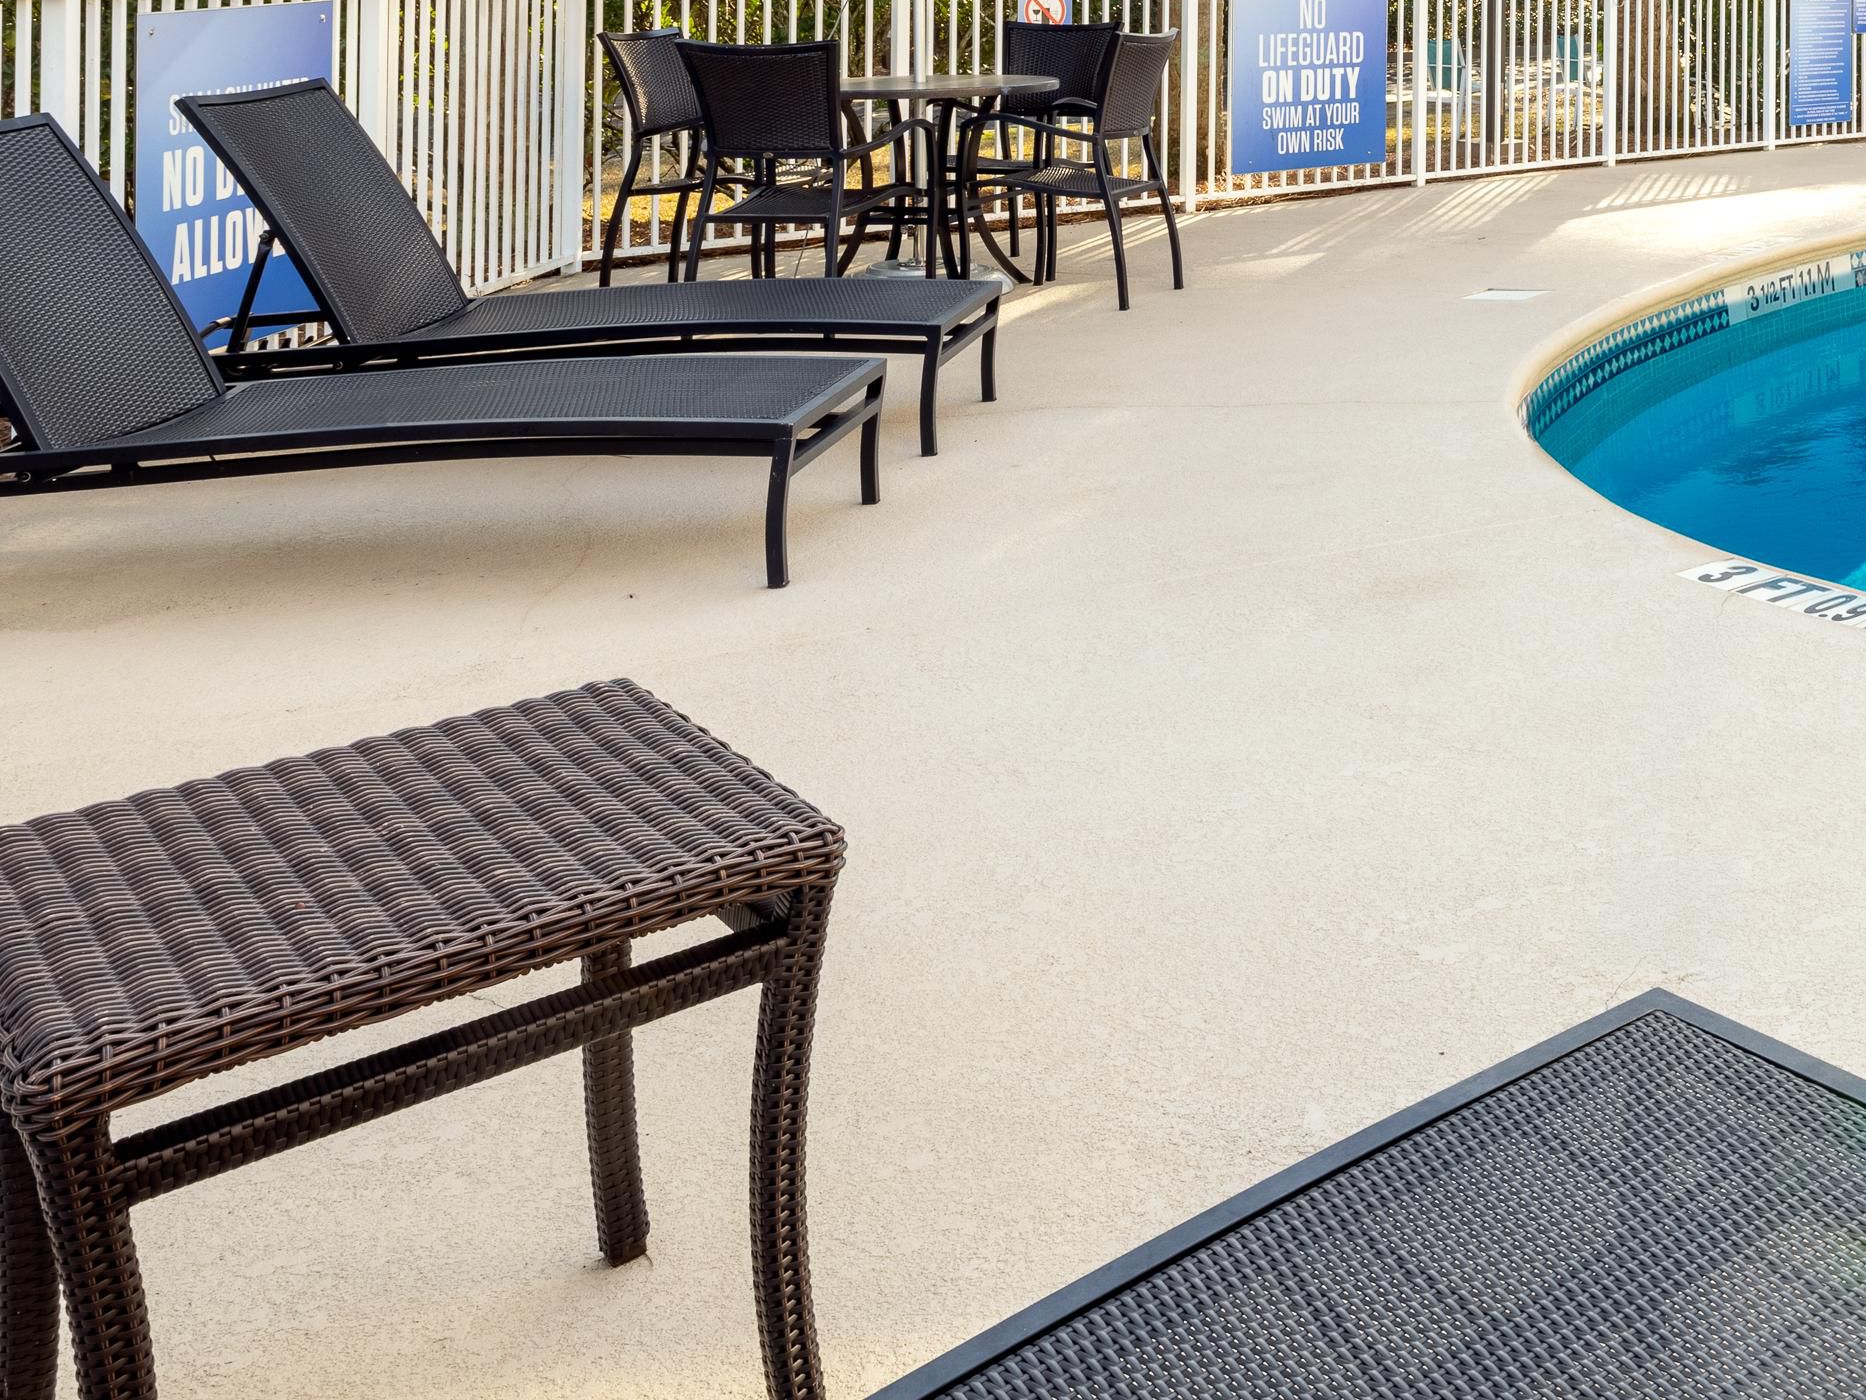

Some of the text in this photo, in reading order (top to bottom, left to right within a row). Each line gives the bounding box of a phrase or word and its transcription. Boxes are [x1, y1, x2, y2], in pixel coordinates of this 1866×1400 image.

[1258, 31, 1364, 67] LIFEGUARD
[1262, 67, 1360, 103] ON DUTY
[1262, 102, 1360, 130] SWIM AT YOUR
[1278, 128, 1344, 155] OWN RISK
[163, 145, 204, 212] NO
[1747, 285, 1760, 312] 3
[1817, 261, 1835, 295] M
[1697, 565, 1758, 585] 3
[1736, 576, 1832, 603] FT
